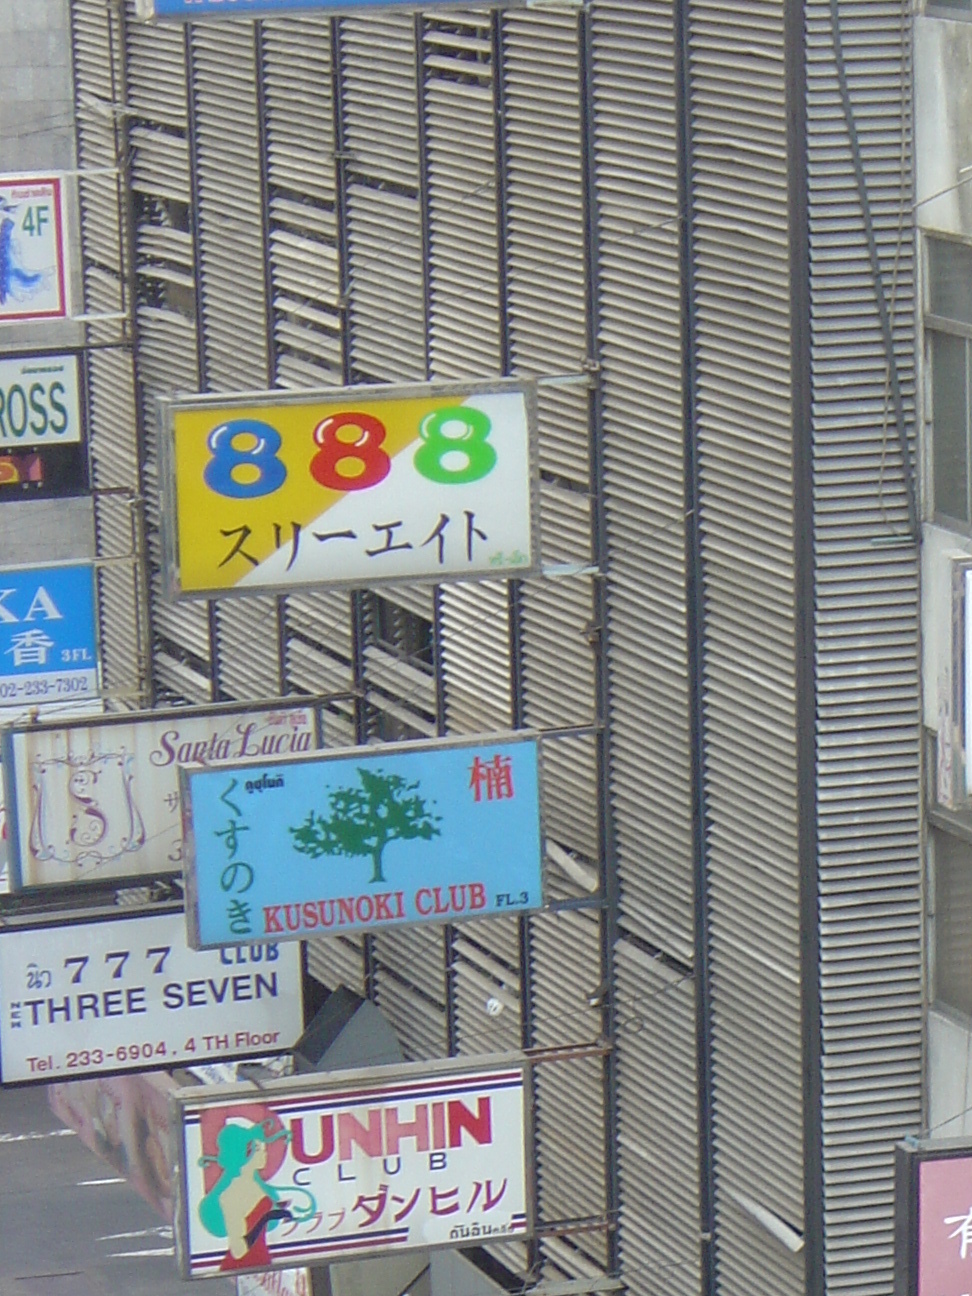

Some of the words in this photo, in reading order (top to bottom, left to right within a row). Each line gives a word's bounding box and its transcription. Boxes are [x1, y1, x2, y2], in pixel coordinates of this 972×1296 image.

[22, 205, 48, 237] 4F
[217, 510, 488, 571] スリーエイト
[61, 648, 92, 662] 3FL
[150, 731, 230, 766] Santa
[232, 722, 312, 757] Lucia
[467, 753, 515, 802] 楠
[213, 778, 255, 936] くすのき
[262, 891, 405, 934] KUSUNOKI
[415, 882, 487, 922] CLUB
[495, 892, 530, 908] FL.3
[24, 986, 147, 1026] THREE
[162, 971, 279, 1010] SEVEN
[27, 1056, 60, 1072] Tel.
[66, 1041, 168, 1069] 233-6904
[203, 1034, 229, 1051] TH
[235, 1030, 281, 1048] Floor
[293, 1151, 448, 1186] CLUB
[352, 1178, 509, 1228] ダンヒル
